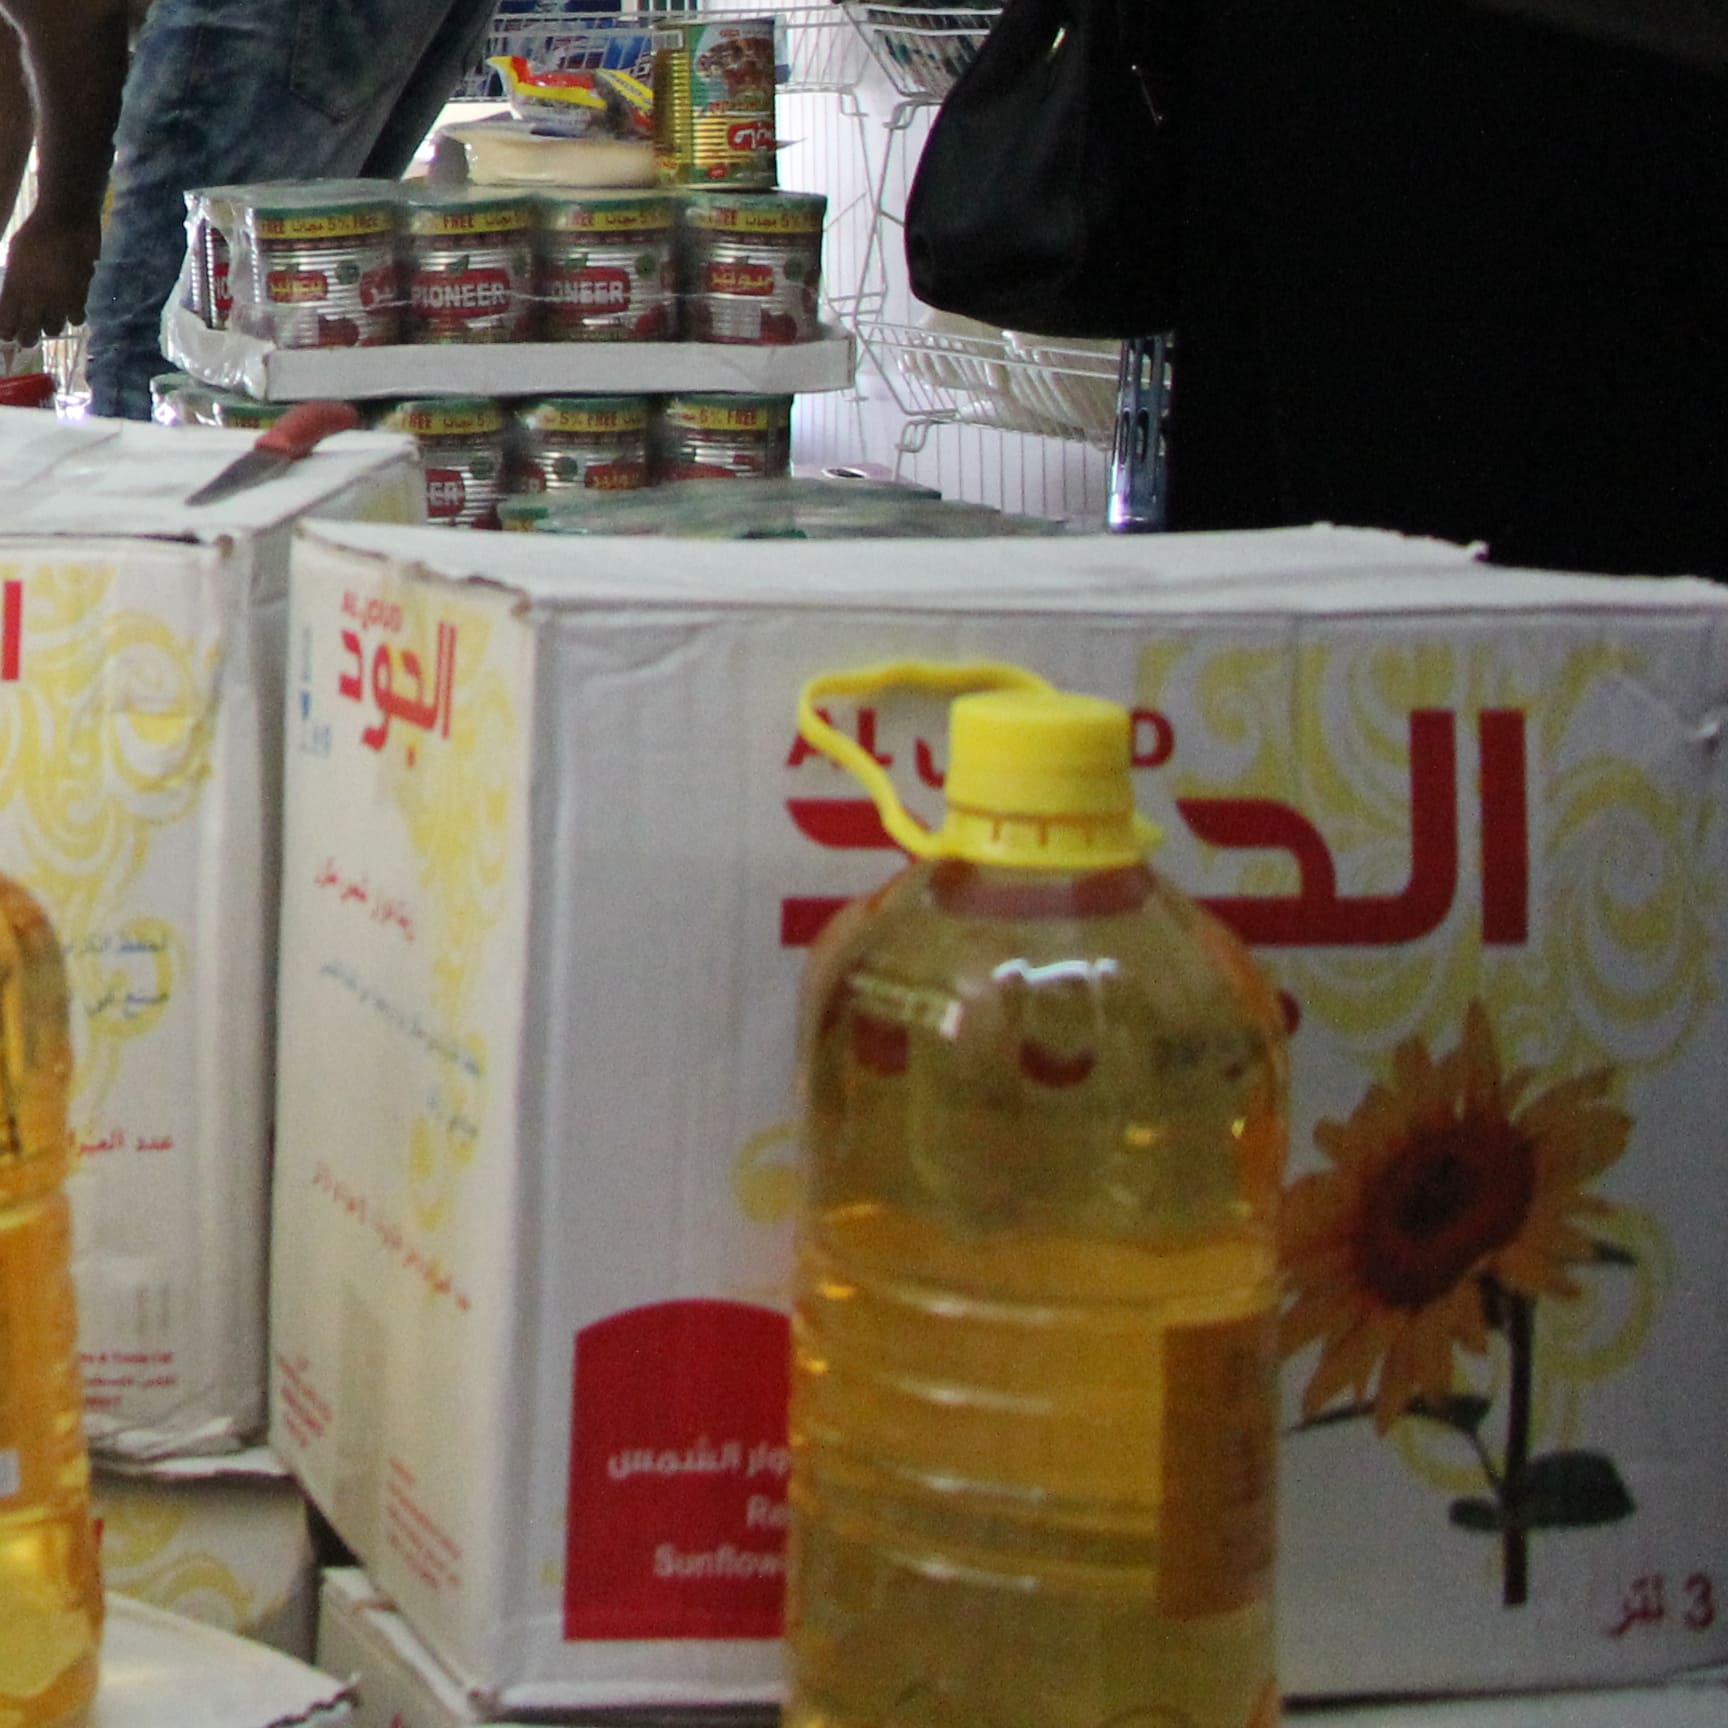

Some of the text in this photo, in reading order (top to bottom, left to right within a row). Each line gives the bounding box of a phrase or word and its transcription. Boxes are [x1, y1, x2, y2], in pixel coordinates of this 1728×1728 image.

[410, 280, 507, 308] PIONEER
[586, 412, 618, 428] FREE
[726, 409, 758, 427] FREE
[338, 620, 458, 769] الجود
[606, 1435, 743, 1481] الشمس
[1604, 1572, 1715, 1640] 3 لتر
